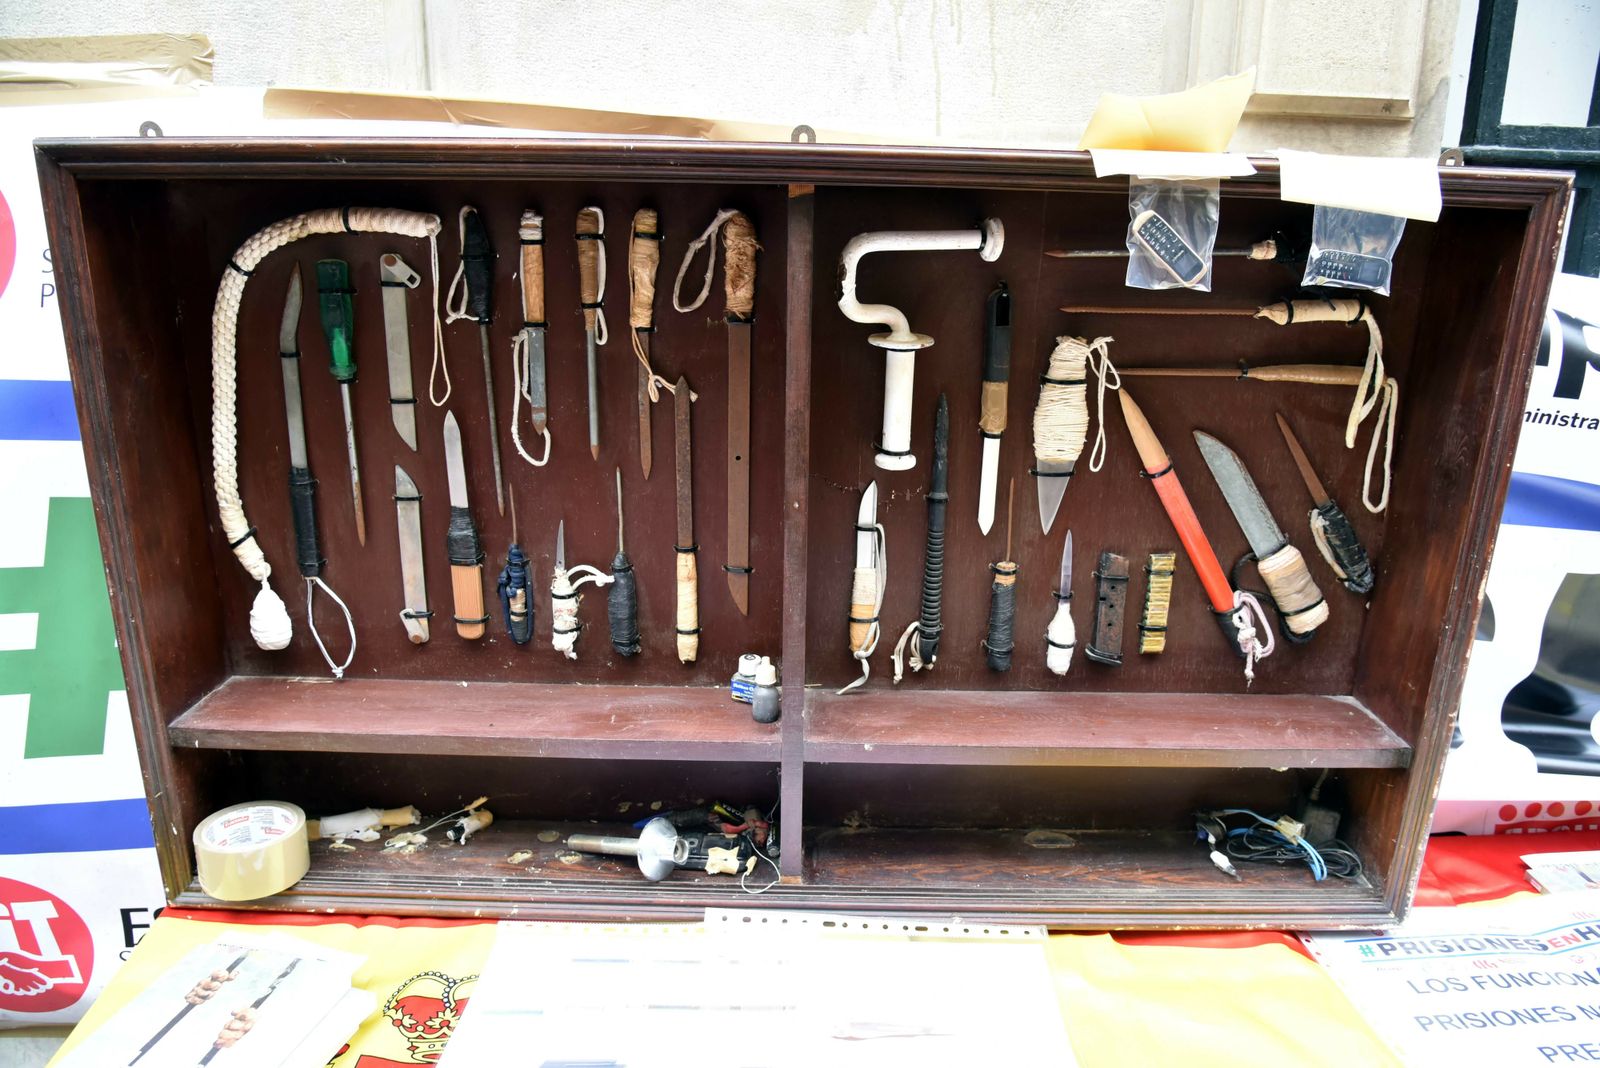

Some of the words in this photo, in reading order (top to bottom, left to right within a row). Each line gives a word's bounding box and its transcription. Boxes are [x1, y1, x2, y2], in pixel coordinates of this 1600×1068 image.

[1358, 925, 1600, 958] #PRISIONESENH
[1406, 977, 1469, 995] LOS
[1413, 1005, 1577, 1032] PRISIONES
[1536, 1042, 1600, 1064] PRE
